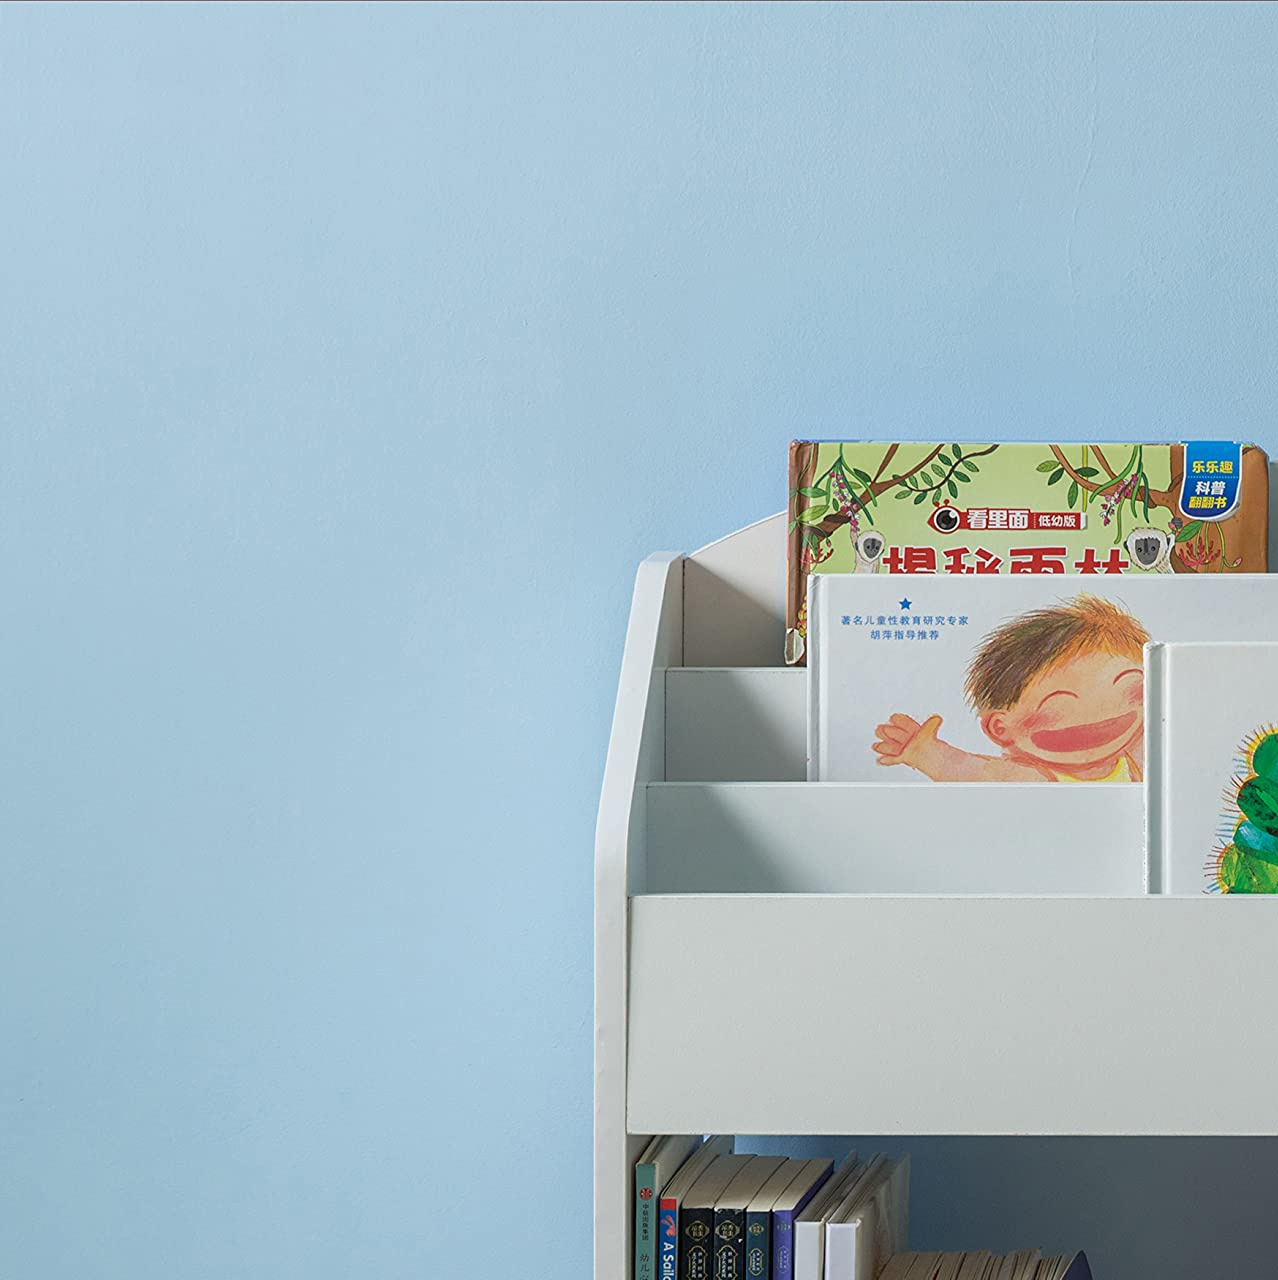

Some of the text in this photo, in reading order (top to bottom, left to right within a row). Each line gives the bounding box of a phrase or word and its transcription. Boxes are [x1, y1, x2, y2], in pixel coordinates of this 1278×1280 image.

[1192, 461, 1233, 473] 乐乐趣
[1195, 481, 1226, 495] 科普
[1188, 496, 1227, 508] 翻翻书
[967, 509, 1076, 529] 看里面 低幼版
[841, 615, 969, 625] 著名儿童性教育研究专家
[663, 1242, 675, 1251] A
